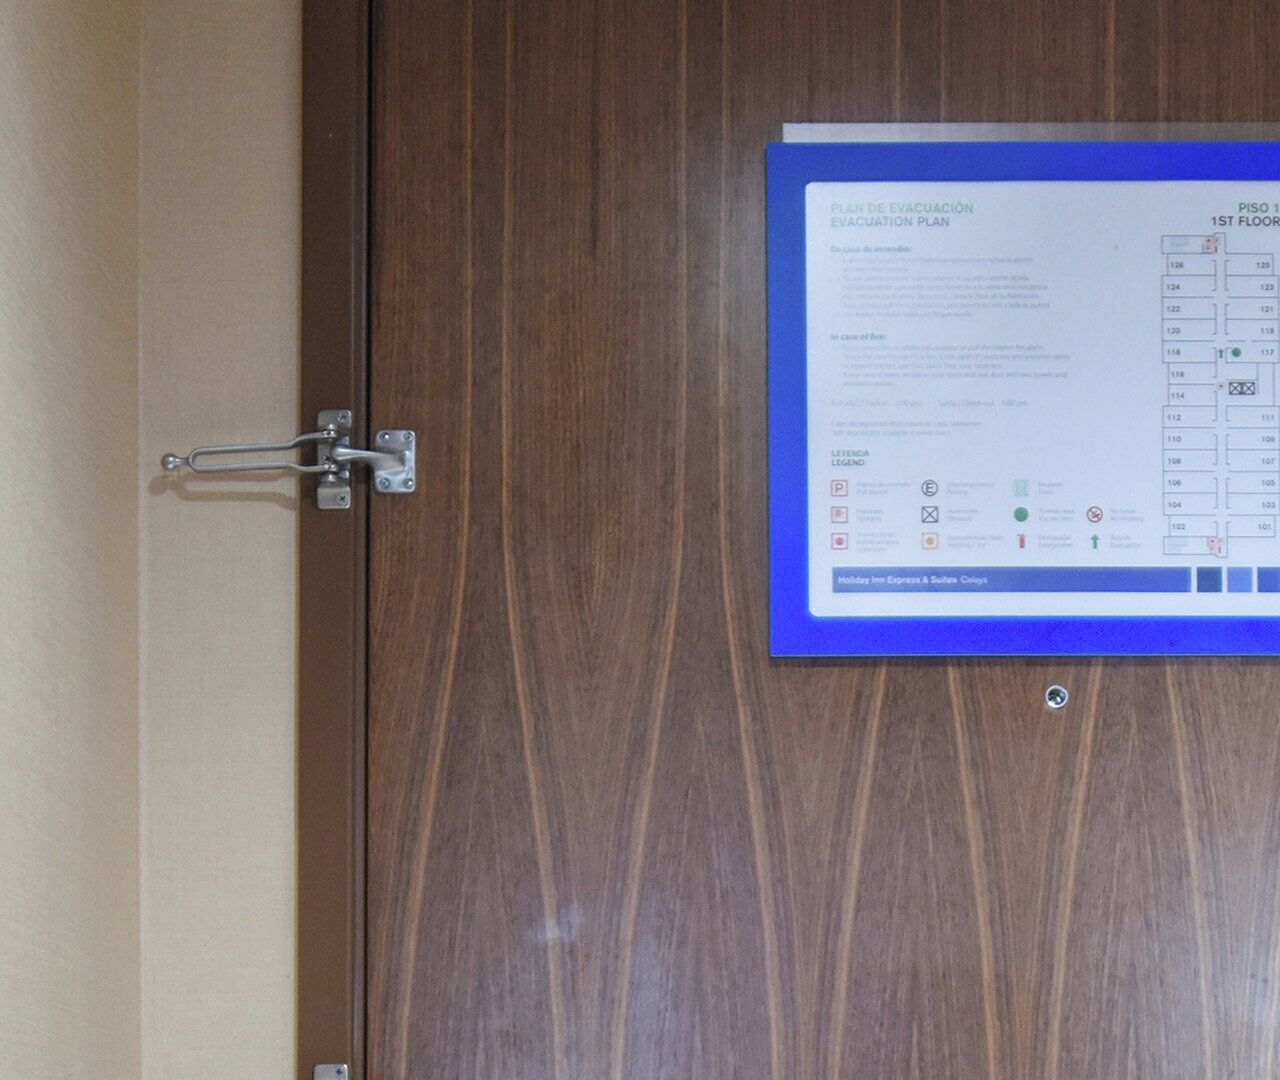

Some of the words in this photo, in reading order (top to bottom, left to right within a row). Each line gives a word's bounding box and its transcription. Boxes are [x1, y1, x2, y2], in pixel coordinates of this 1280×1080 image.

[830, 202, 864, 214] PLAN
[868, 202, 885, 214] DE
[889, 200, 975, 214] EVACUACIÓN
[1238, 203, 1269, 213] PISO
[1274, 203, 1279, 212] 1
[830, 216, 913, 227] EVACUATION
[917, 216, 951, 227] PLAN
[1212, 216, 1234, 226] 1ST
[1238, 216, 1280, 226] FLOOR
[831, 449, 869, 457] LEYENDA
[831, 458, 866, 466] LEGEND
[838, 576, 870, 585] Holiday
[872, 576, 885, 584] Inn
[887, 576, 920, 585] Express
[930, 576, 957, 584] Suites
